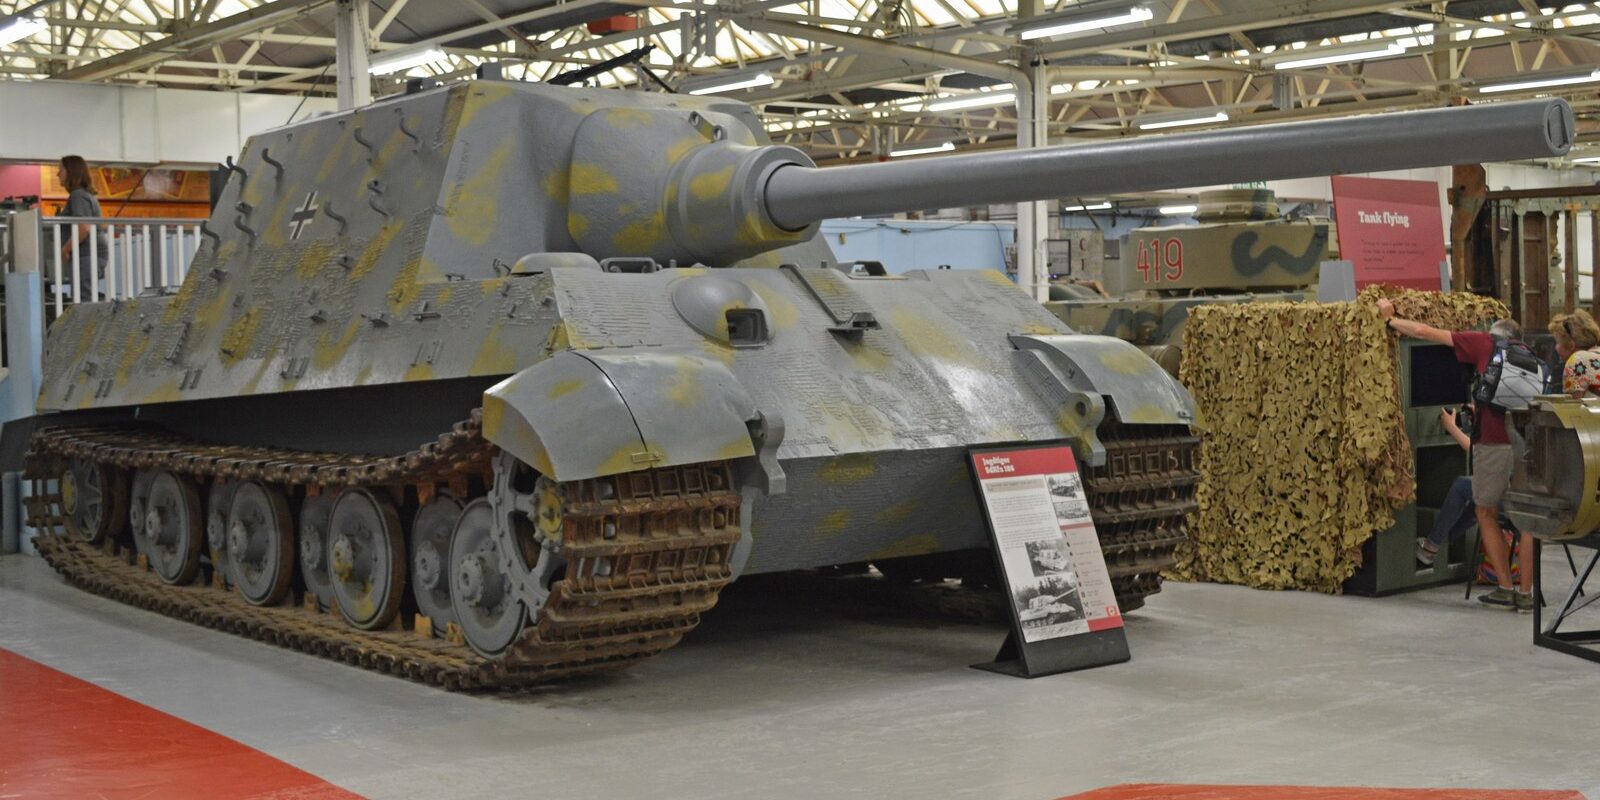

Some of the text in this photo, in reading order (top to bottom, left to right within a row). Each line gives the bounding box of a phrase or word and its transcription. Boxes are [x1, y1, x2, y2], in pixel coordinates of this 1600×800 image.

[1358, 211, 1410, 228] Tank flying
[1136, 236, 1185, 284] 419
